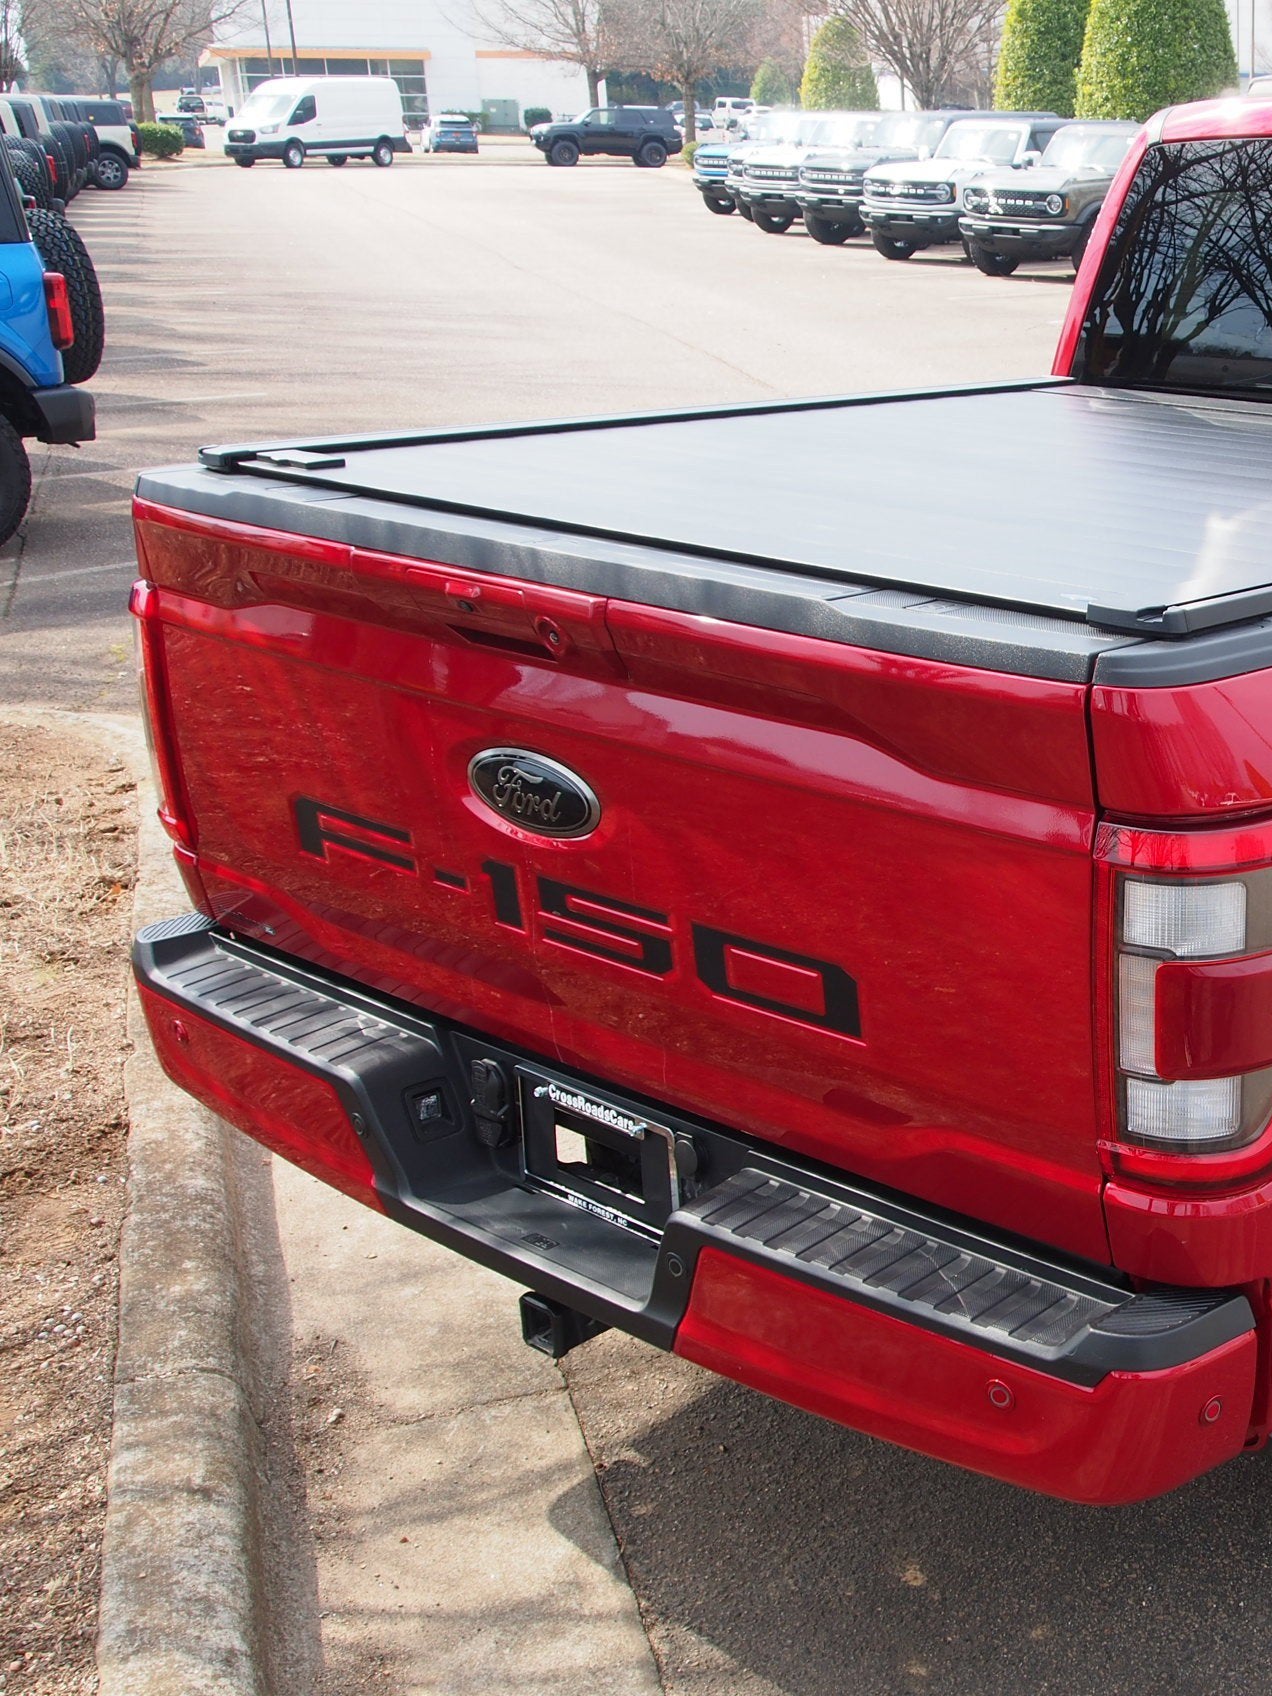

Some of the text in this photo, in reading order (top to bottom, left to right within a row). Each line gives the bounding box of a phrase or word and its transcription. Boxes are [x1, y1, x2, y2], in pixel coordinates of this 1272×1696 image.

[492, 765, 561, 822] Ford
[294, 796, 864, 1038] F-150
[548, 1083, 635, 1131] CrossRoadsCars
[567, 1194, 587, 1209] WAKE
